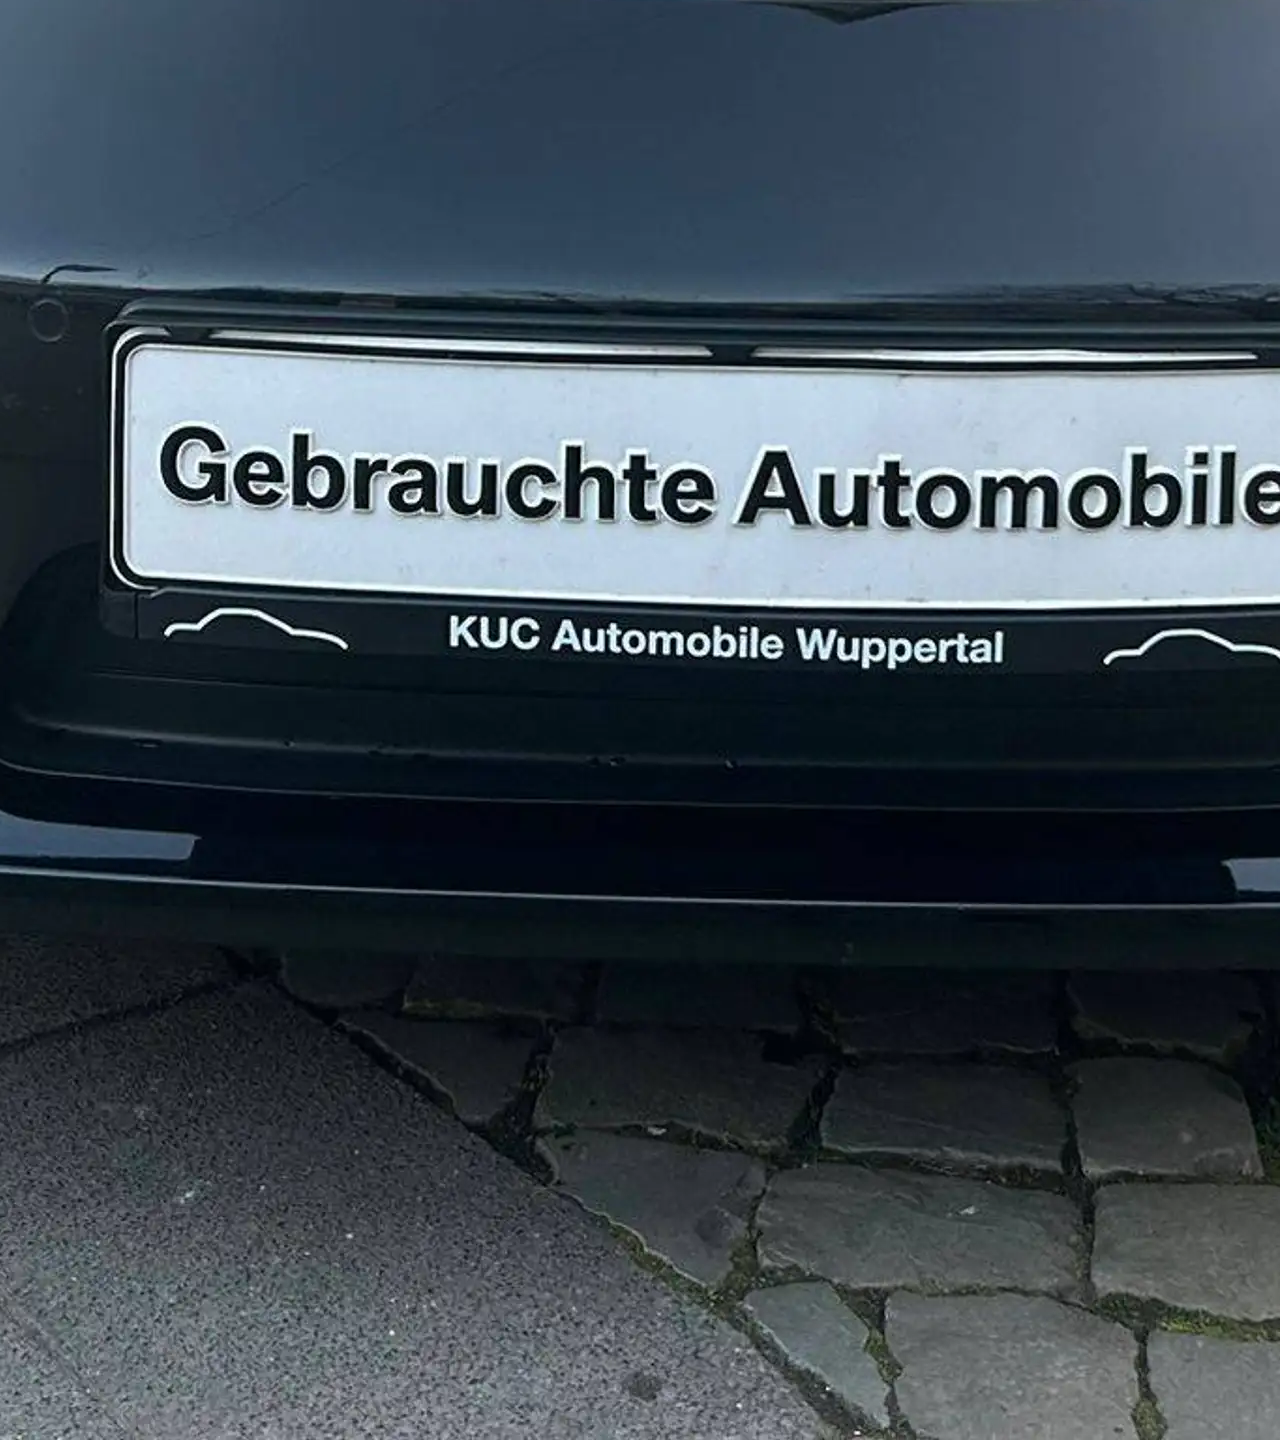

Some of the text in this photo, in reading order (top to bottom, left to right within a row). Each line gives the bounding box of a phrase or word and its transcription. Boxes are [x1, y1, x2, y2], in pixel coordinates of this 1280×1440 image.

[158, 422, 717, 524] Gebrauchte
[449, 616, 1004, 668] KUC Automobile Wuppertal
